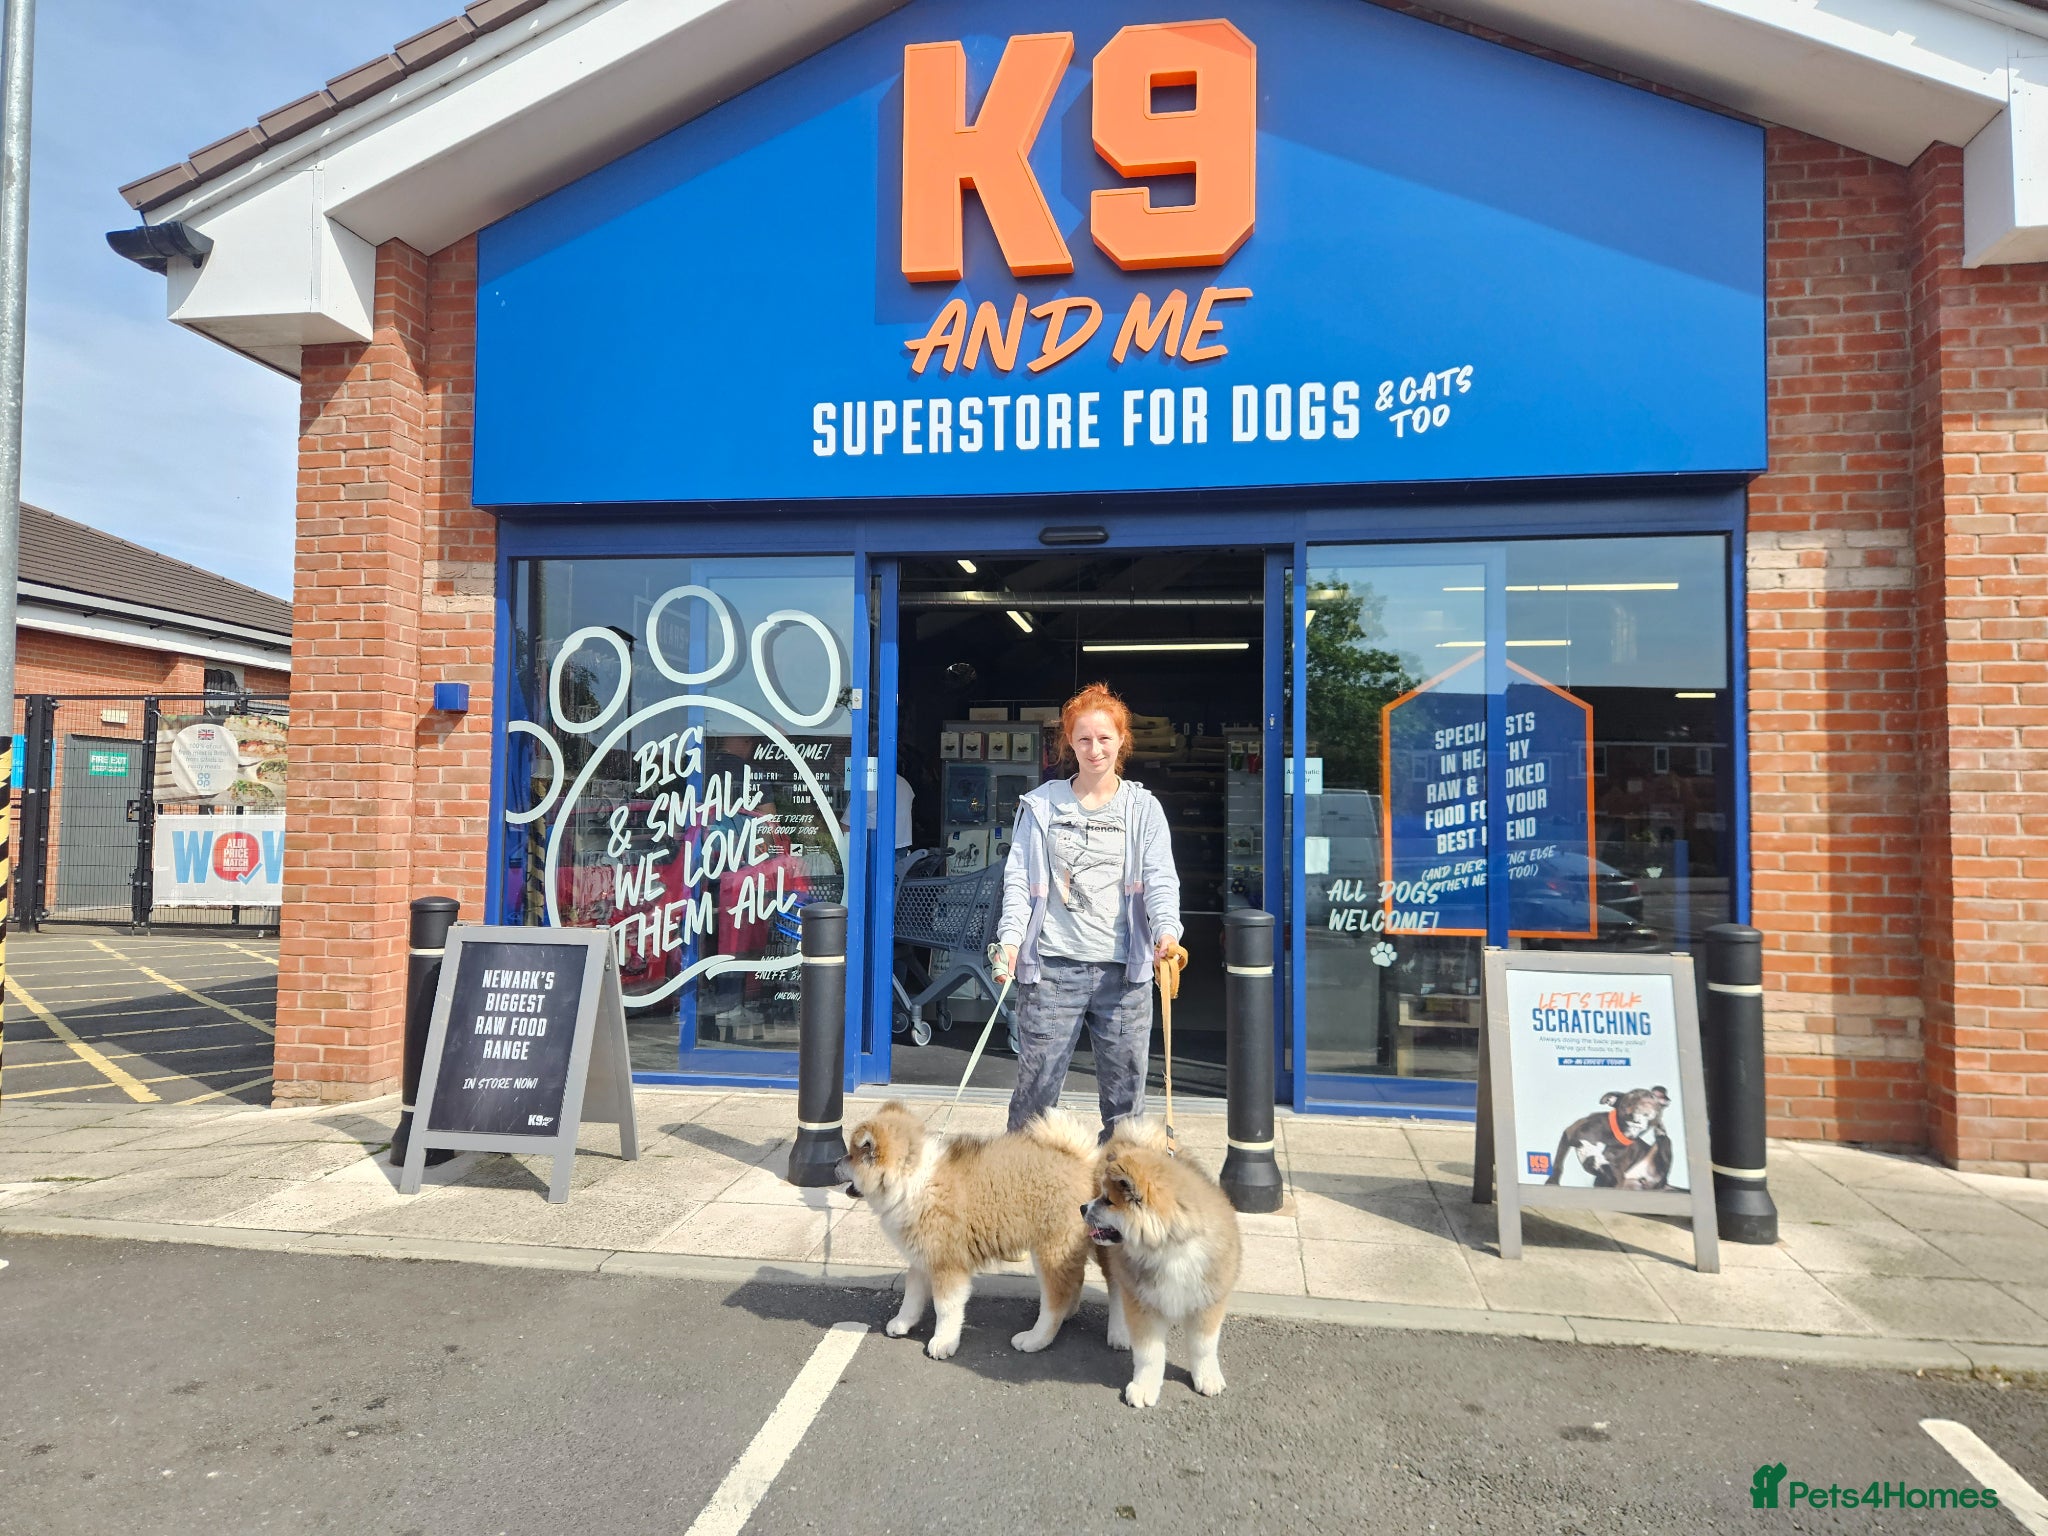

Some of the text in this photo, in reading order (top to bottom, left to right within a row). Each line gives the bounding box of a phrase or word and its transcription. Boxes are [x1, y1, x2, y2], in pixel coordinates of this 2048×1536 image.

[902, 18, 1256, 282] K9
[904, 287, 1253, 374] AND ME
[813, 380, 1360, 457] SUPERSTORE FOR DOGS
[1388, 402, 1451, 438] TOO
[91, 755, 127, 765] FIRE EXIT
[633, 726, 704, 794] BIG
[1441, 739, 1530, 775] IN HEHY
[1427, 779, 1461, 804] RAW
[1466, 776, 1478, 796] &
[607, 764, 763, 858] & SMALL
[784, 814, 814, 823] TREATS
[1425, 788, 1547, 831] FOOD FO YOUR
[226, 838, 247, 848] ALDI
[757, 826, 819, 835] FOR GOOD DOGS
[1437, 828, 1476, 855] BEST
[223, 848, 249, 858] PRICE
[223, 858, 249, 867] MATCH
[615, 813, 774, 910] WE LOVE
[1421, 864, 1451, 881] (AND
[1529, 844, 1557, 861] ELSE
[1326, 879, 1441, 904] ALL DOGS
[1440, 876, 1469, 893] THEY
[610, 891, 713, 966] THEM
[727, 866, 798, 929] ALL
[1328, 908, 1440, 933] WELCOME!
[482, 969, 555, 990] NEWARK'S
[485, 993, 545, 1013] BIGGEST
[1539, 991, 1642, 1009] LET'S TALK
[474, 1016, 547, 1037] RAW FOOD
[1532, 1008, 1651, 1036] SCRATCHING
[482, 1040, 530, 1060] RANGE
[462, 1077, 539, 1090] IN STORE NOW!
[528, 1114, 543, 1126] K9
[1530, 1155, 1549, 1169] K9
